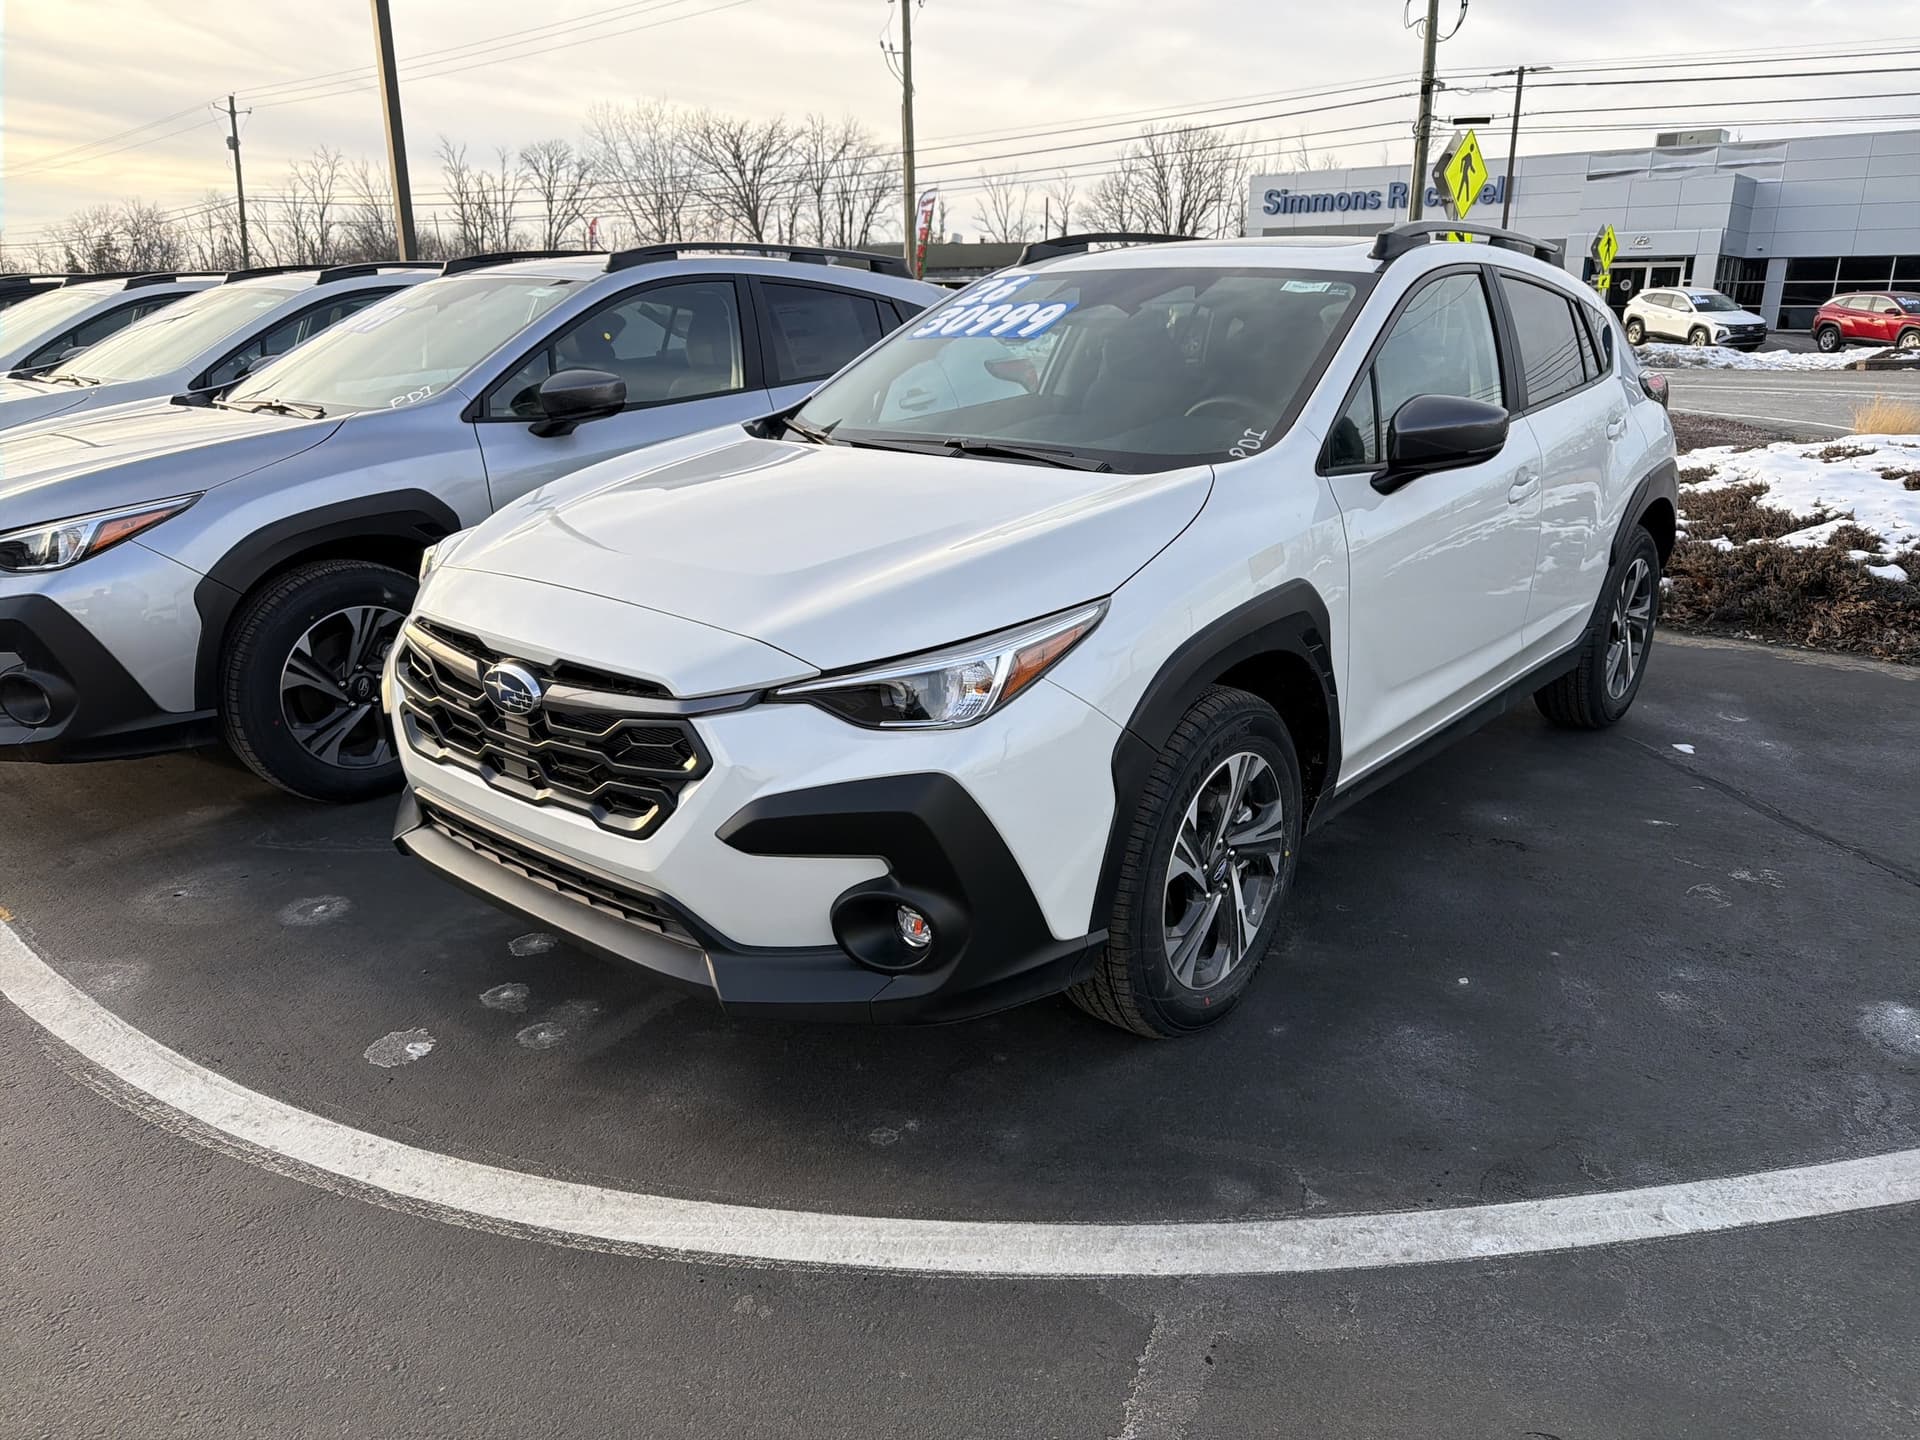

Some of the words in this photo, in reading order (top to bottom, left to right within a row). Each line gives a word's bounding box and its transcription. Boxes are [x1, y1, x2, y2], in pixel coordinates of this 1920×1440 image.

[1263, 188, 1382, 215] Simmons
[953, 276, 1031, 306] 26
[912, 303, 1067, 338] 30999
[1229, 428, 1267, 458] PDI
